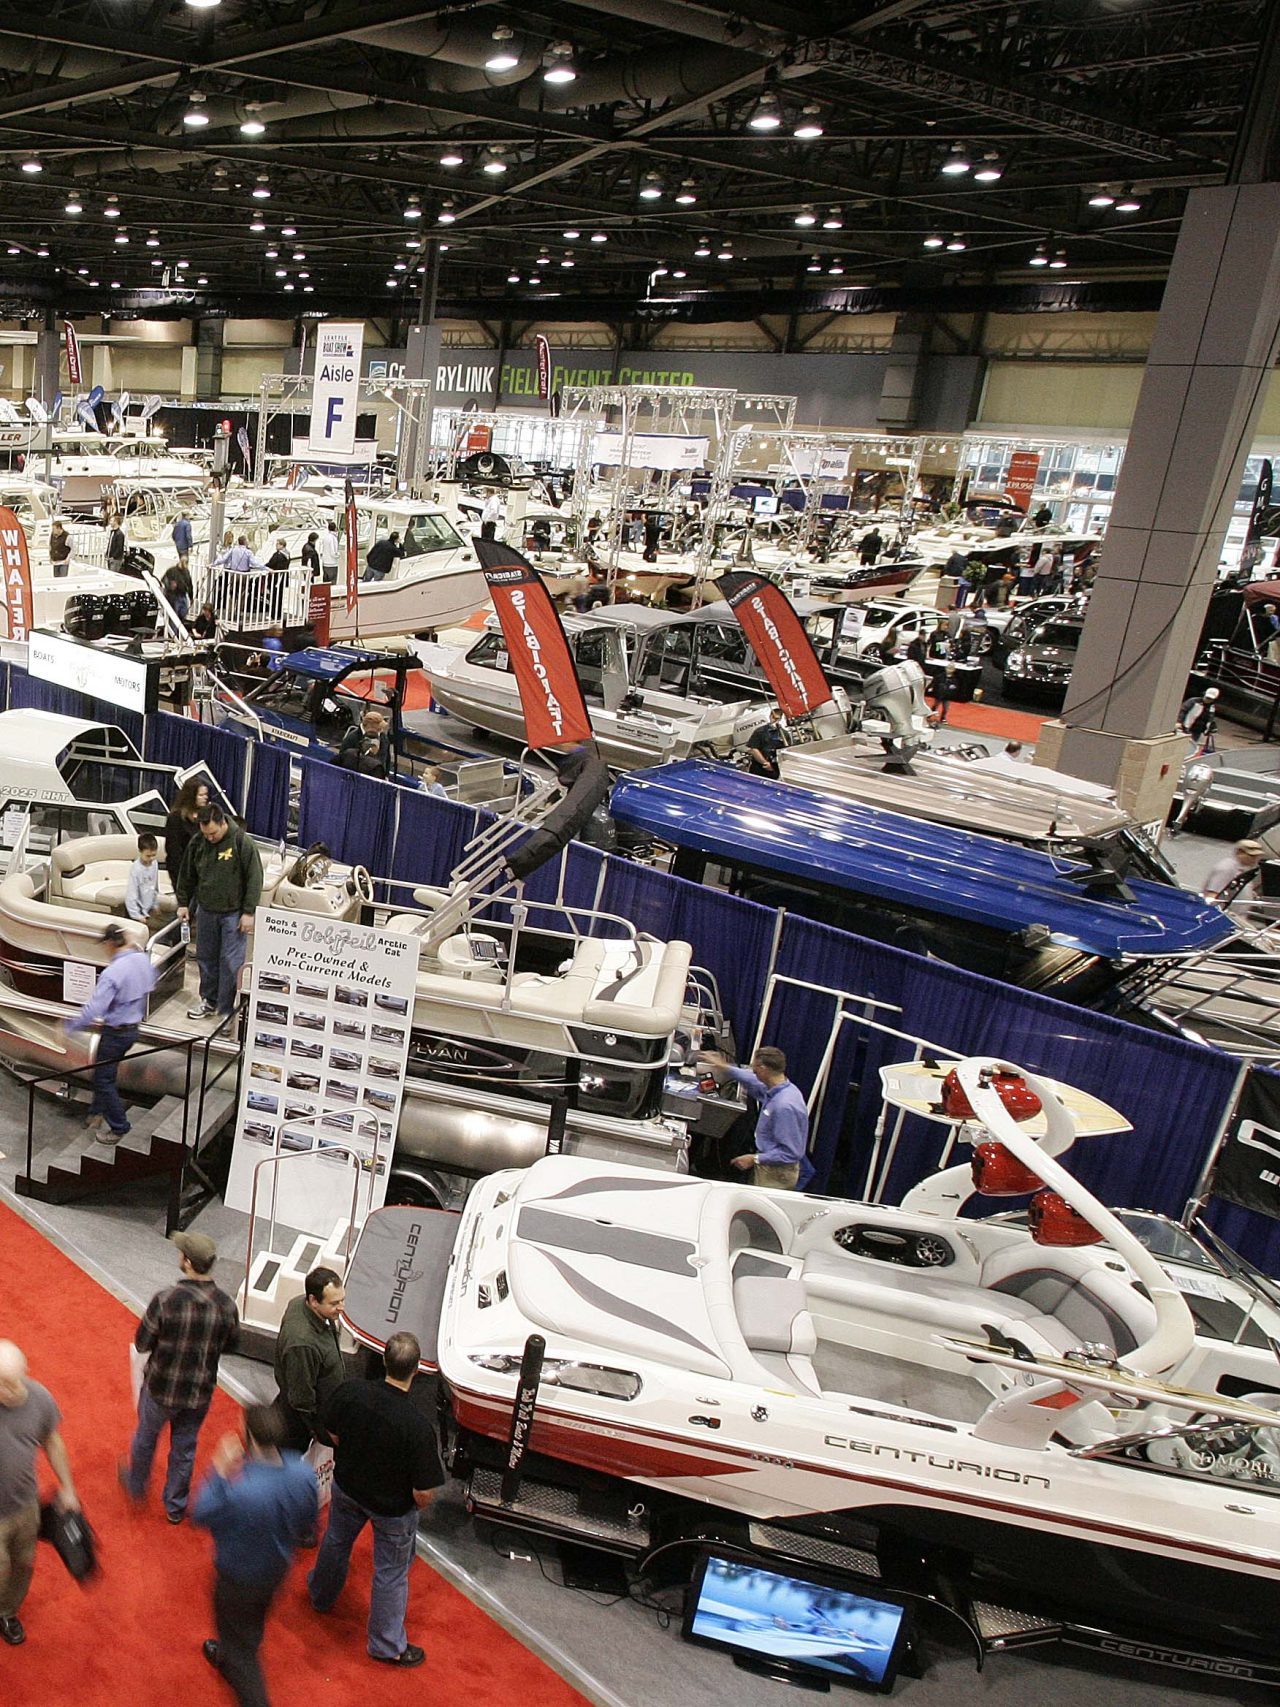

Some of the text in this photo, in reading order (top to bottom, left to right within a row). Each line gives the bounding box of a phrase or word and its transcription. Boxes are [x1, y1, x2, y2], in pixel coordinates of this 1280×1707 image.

[323, 342, 347, 354] BOAT SHOW
[320, 365, 354, 382] Aisle
[325, 397, 344, 439] F
[33, 650, 55, 663] BOATS
[114, 676, 141, 692] MOTORS
[0, 786, 69, 801] 2025 HHT
[265, 916, 288, 927] Boats
[268, 925, 297, 936] Motors
[377, 938, 408, 950] Arctic
[286, 946, 370, 973] Pre-Owned &
[385, 948, 401, 957] Cat
[267, 955, 392, 989] Non-Current Models
[385, 1223, 422, 1324] CENTURION
[824, 1435, 1051, 1489] CENTURION
[1099, 1639, 1254, 1677] CENTURION
